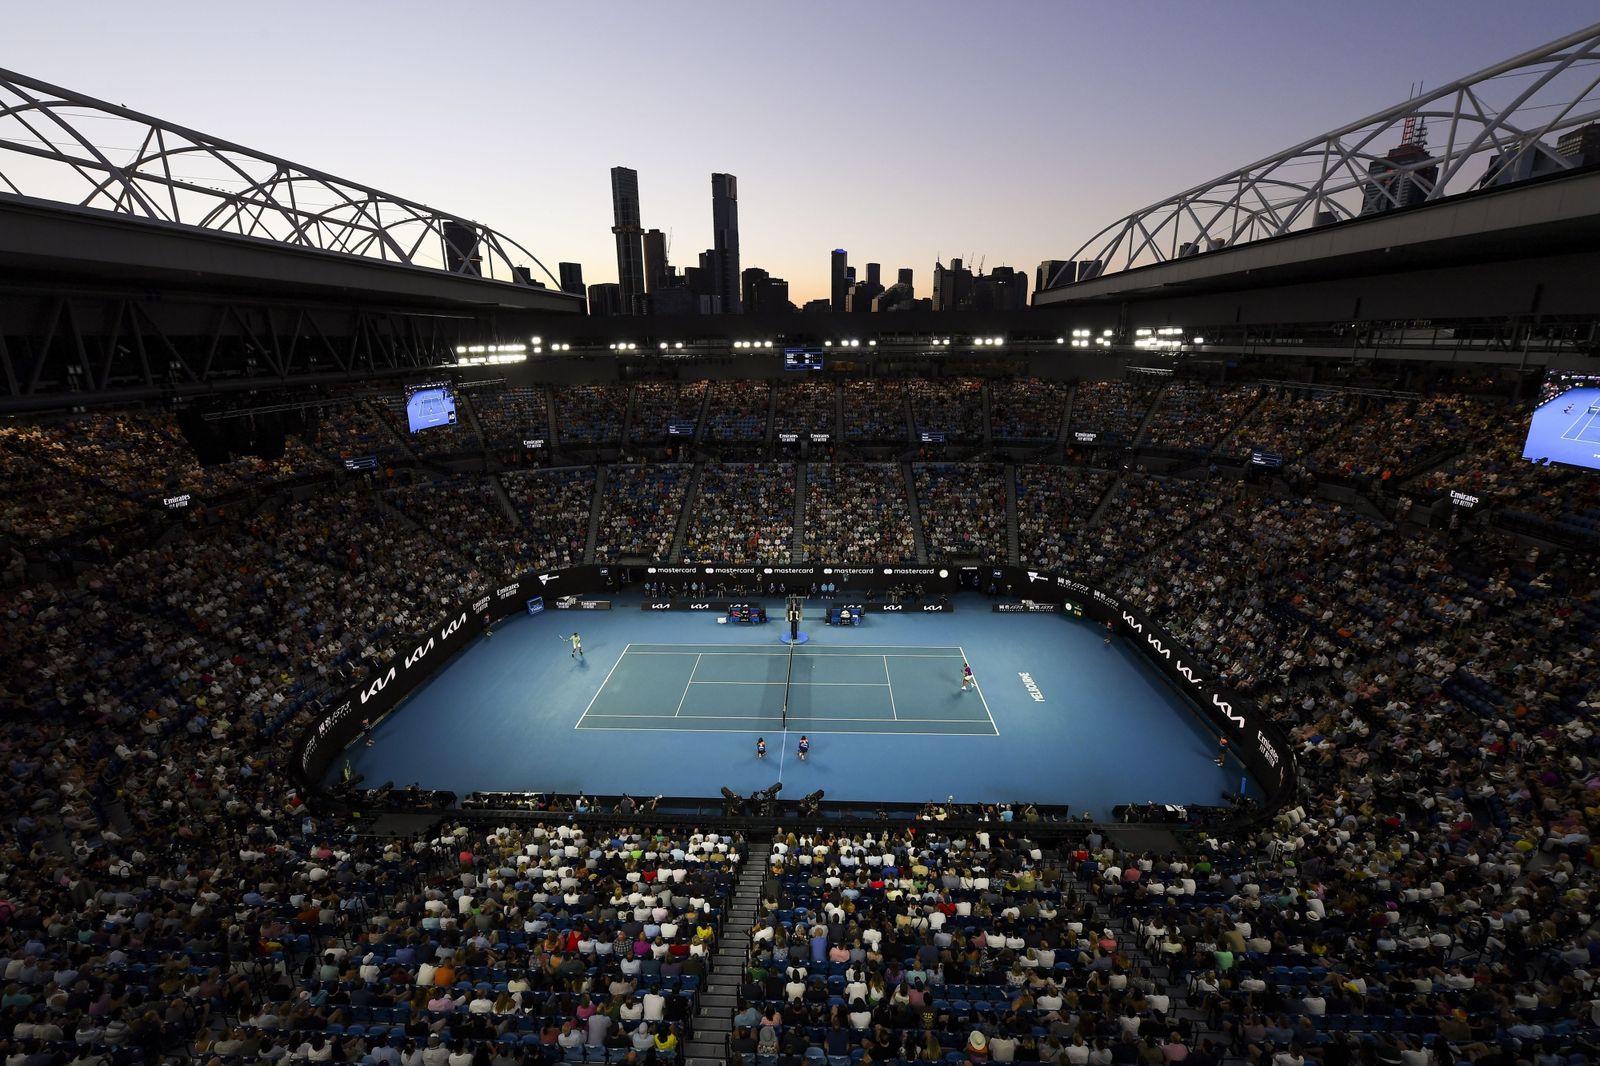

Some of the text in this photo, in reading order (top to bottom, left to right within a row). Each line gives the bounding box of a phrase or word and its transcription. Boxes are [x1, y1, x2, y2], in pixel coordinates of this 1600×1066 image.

[163, 494, 191, 506] Emirates
[1450, 490, 1479, 504] Emirates
[441, 612, 467, 640] KIA
[1122, 610, 1143, 633] KIA
[404, 637, 435, 669] KIA
[1147, 633, 1171, 660] KIA
[360, 667, 396, 704] KIA
[1212, 694, 1246, 729] KIA
[1257, 730, 1279, 764] Emirates
